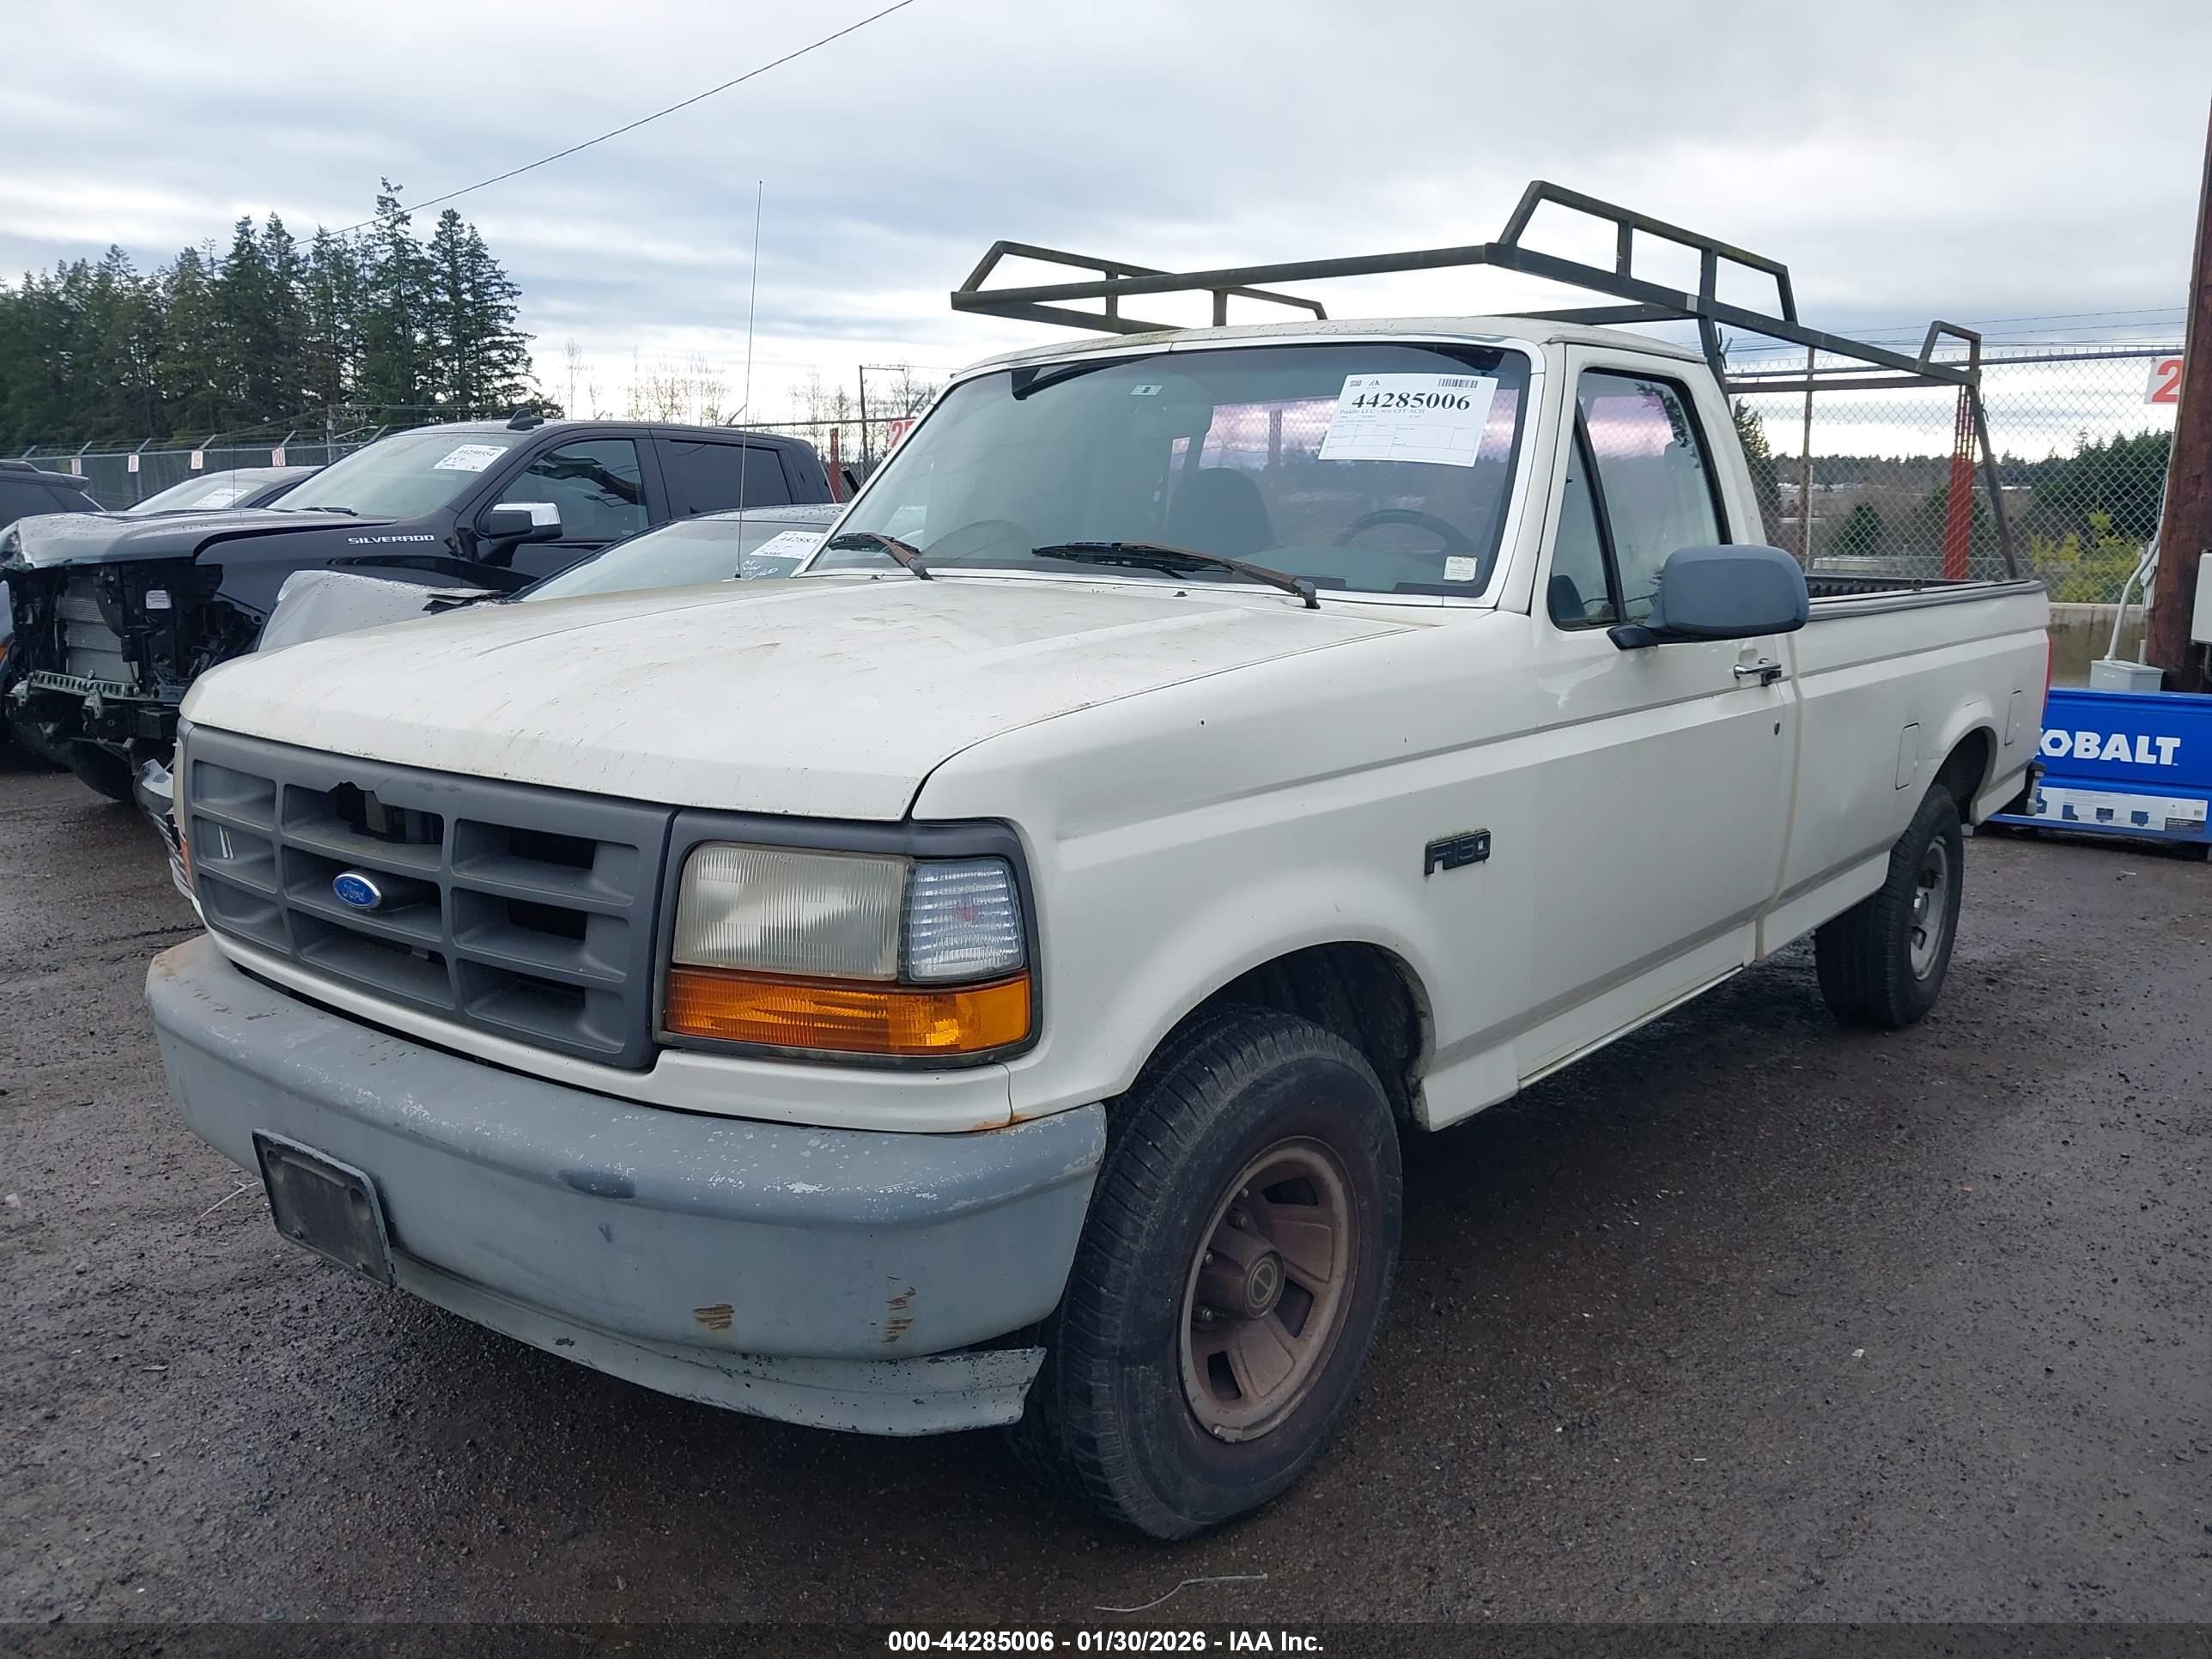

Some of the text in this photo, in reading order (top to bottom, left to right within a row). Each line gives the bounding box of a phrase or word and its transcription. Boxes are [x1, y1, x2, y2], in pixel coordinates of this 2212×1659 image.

[1351, 392, 1473, 410] 44285006
[273, 449, 283, 465] 20
[348, 534, 435, 544] SILVERADO
[2036, 727, 2181, 765] OBALT
[341, 880, 367, 902] Ford
